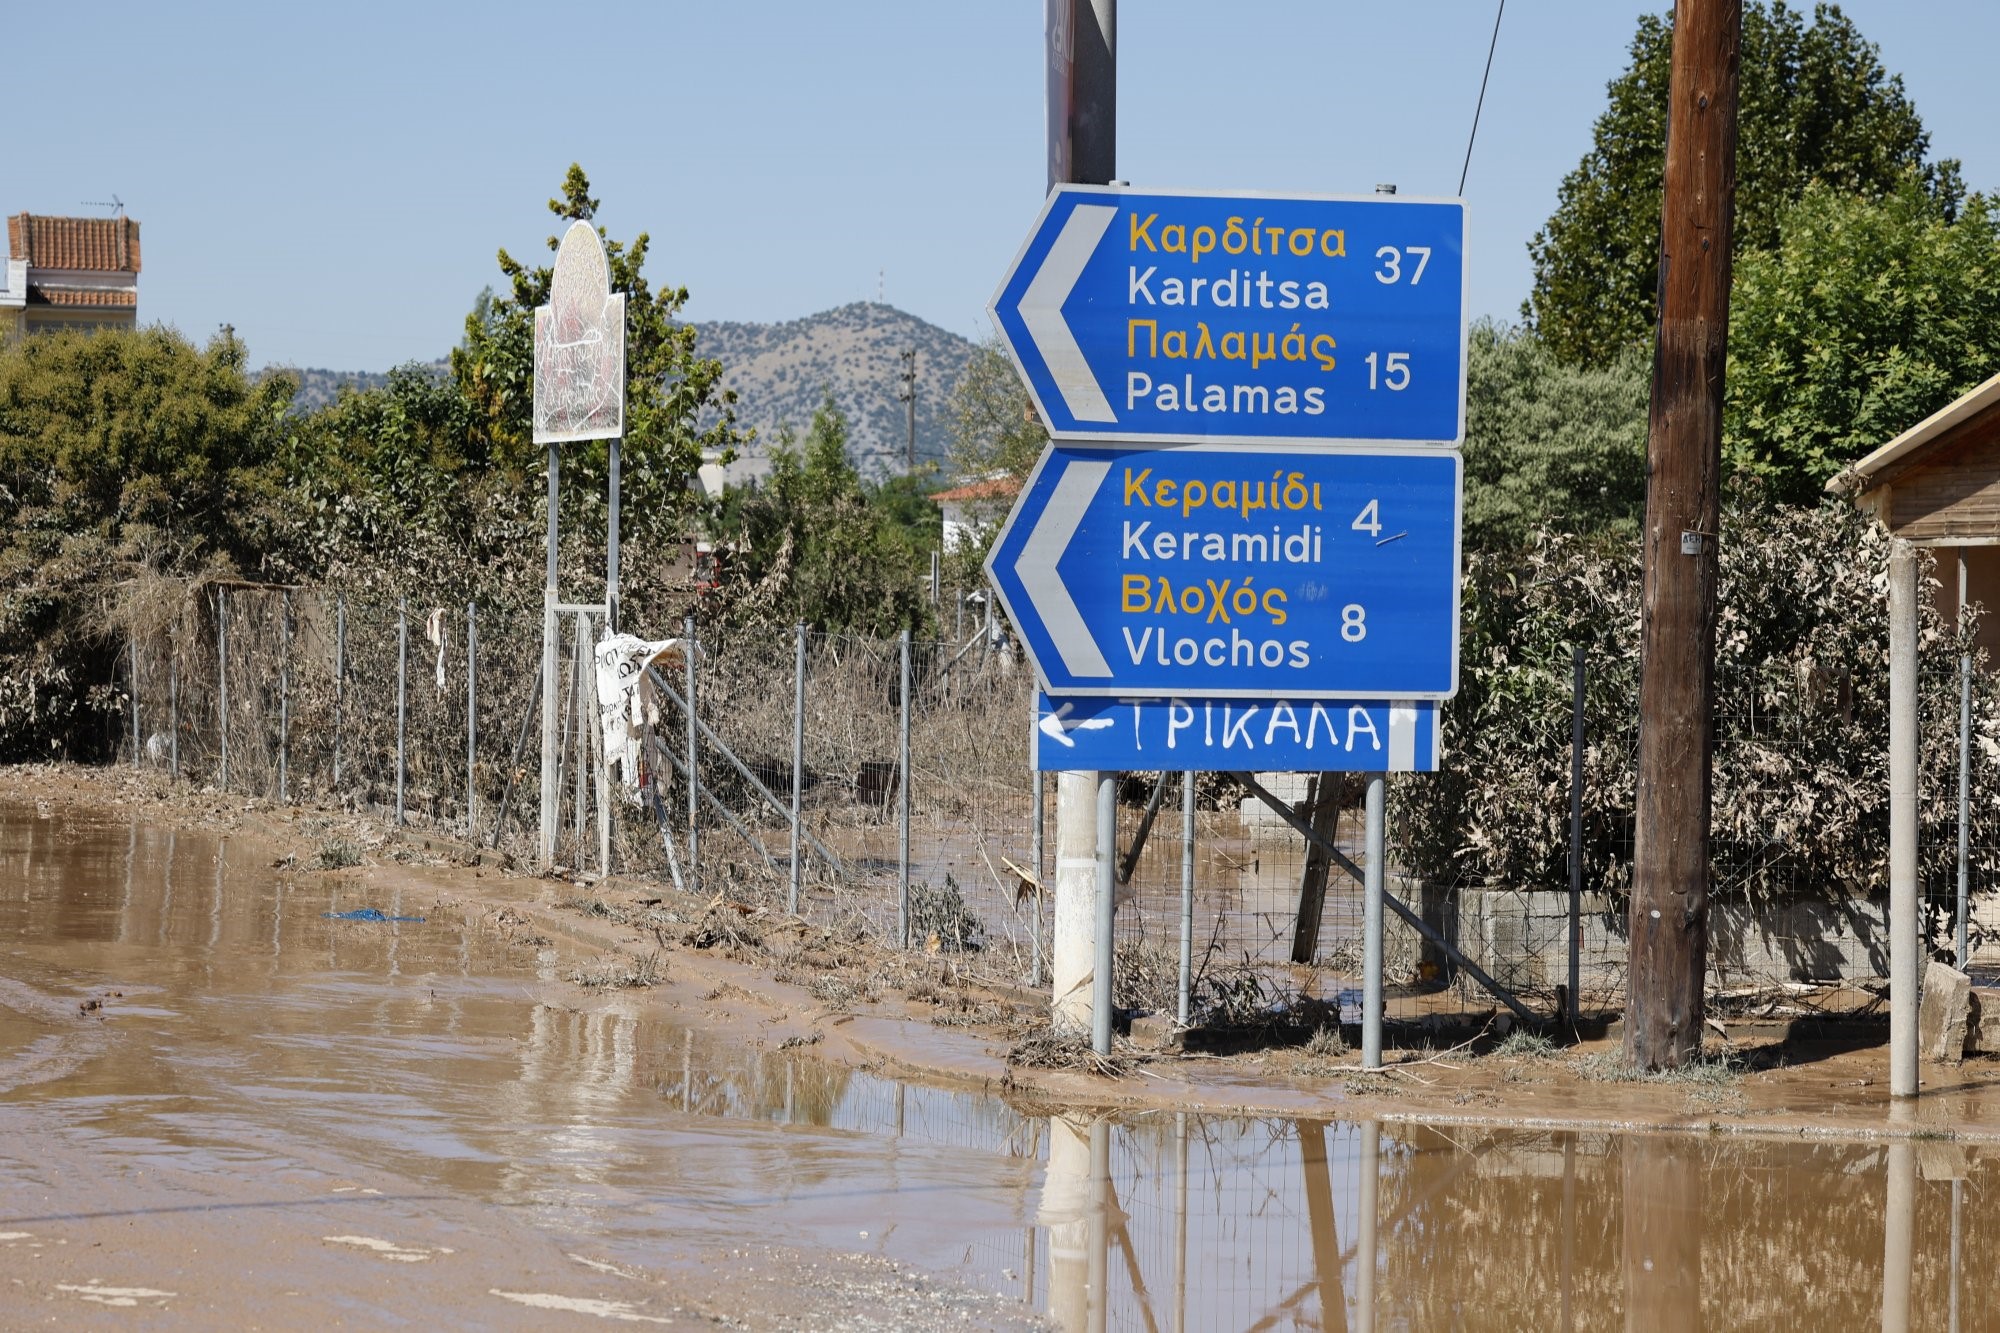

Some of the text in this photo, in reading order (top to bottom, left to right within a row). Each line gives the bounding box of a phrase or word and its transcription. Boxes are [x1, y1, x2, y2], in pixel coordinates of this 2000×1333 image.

[1129, 212, 1347, 264] Καρδίτσα
[1128, 265, 1330, 311] Karditsa
[1374, 245, 1431, 286] 37
[1127, 319, 1337, 372] Παλαμάς
[1127, 371, 1326, 416] Palamas
[1365, 351, 1411, 391] 15
[1123, 468, 1323, 520] Κεραμίδι
[1351, 499, 1382, 538] 4
[1122, 520, 1322, 563] Keramidi
[1121, 574, 1289, 625] Βλοχός
[1340, 603, 1367, 643] 8
[1122, 626, 1311, 669] Vlochos
[1119, 697, 1381, 752] ΤΡΙΚΑΛΑ
